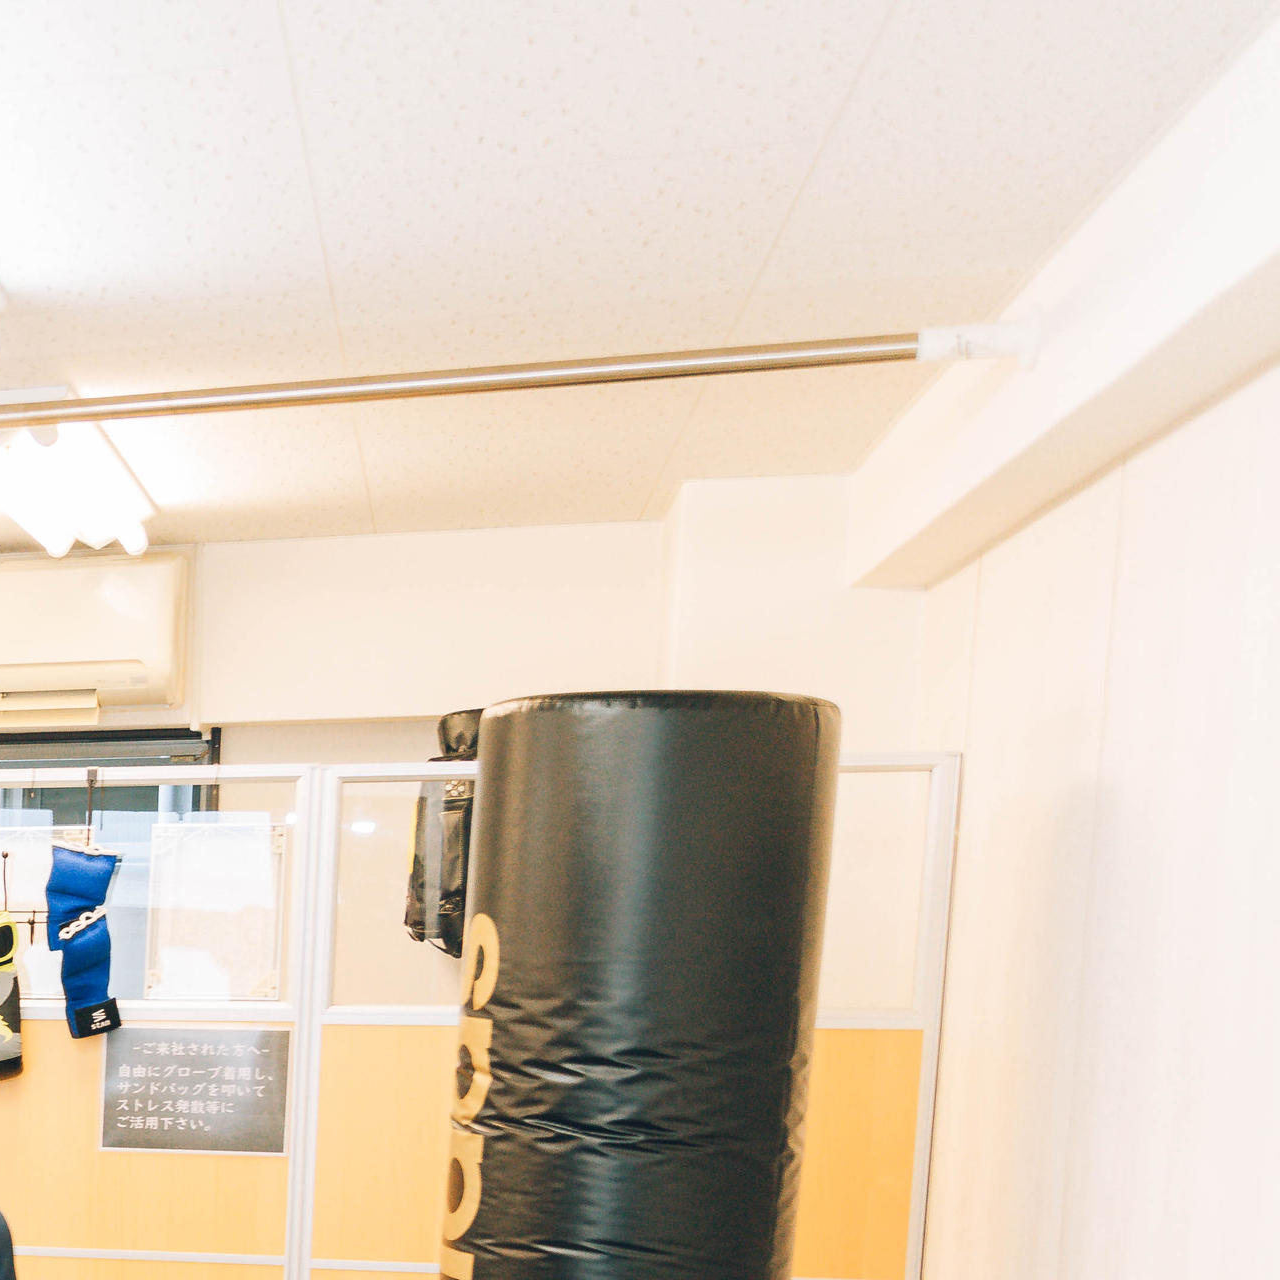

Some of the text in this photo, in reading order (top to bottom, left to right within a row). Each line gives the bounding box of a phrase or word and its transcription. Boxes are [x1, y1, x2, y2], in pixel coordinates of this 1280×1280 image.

[116, 1081, 266, 1098] サンドバッグを叩いて
[115, 1099, 235, 1115] ストレス発散等に
[116, 1115, 212, 1132] ご活用下さい。
